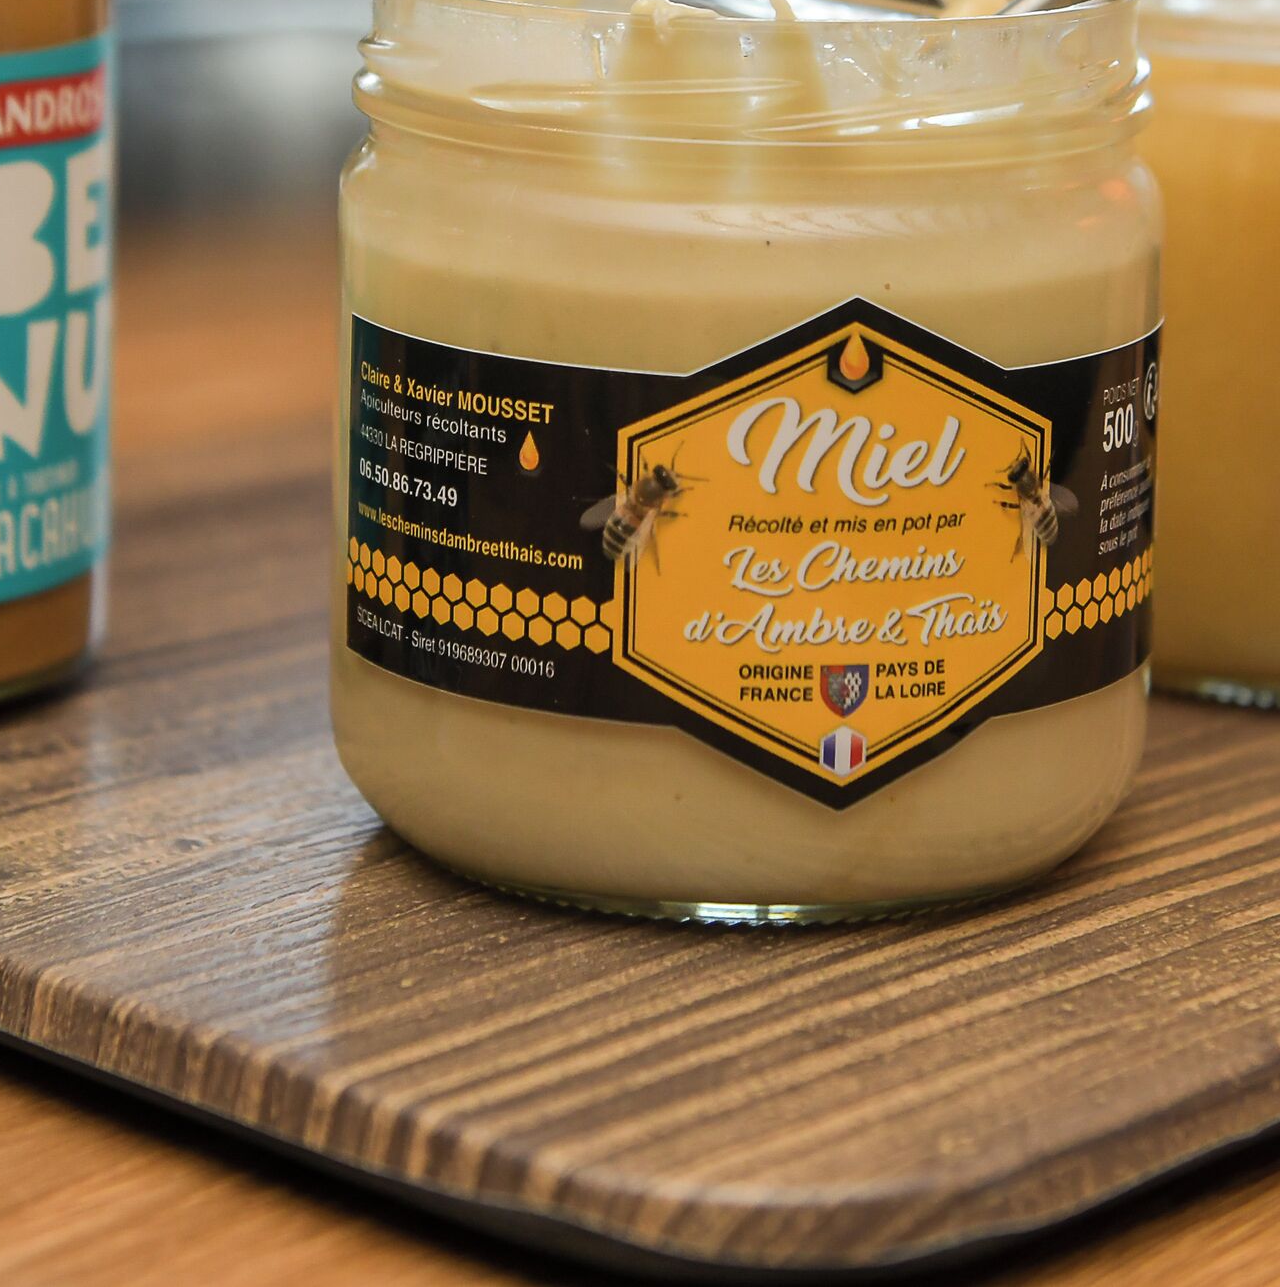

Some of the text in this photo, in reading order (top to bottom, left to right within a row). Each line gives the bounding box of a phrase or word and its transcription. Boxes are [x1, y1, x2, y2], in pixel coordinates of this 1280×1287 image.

[360, 360, 555, 425] Claire & Xavier MOUSSET
[360, 388, 508, 444] Apiculteurs récoltants
[360, 422, 384, 448] 44330
[385, 432, 398, 453] LA
[726, 396, 967, 507] Miel
[359, 456, 459, 508] 06.50.86.73.49
[357, 500, 584, 571] www.lescheminsdambreetthais.com
[728, 512, 966, 535] Récolté et mis en pot par
[1099, 517, 1108, 534] la
[1097, 535, 1118, 556] sous
[723, 540, 966, 597] Les Chemins
[356, 604, 379, 634] SCEA
[378, 618, 404, 642] LCAT
[411, 630, 436, 655] Siret
[437, 640, 508, 671] 919689307
[510, 654, 556, 680] 00016
[683, 592, 1008, 654] d'Ambre & Thaïs
[738, 663, 814, 681] ORIGINE
[875, 659, 946, 678] PAYS DE
[738, 686, 813, 703] FRANCE
[875, 680, 946, 700] LA LOIRE
